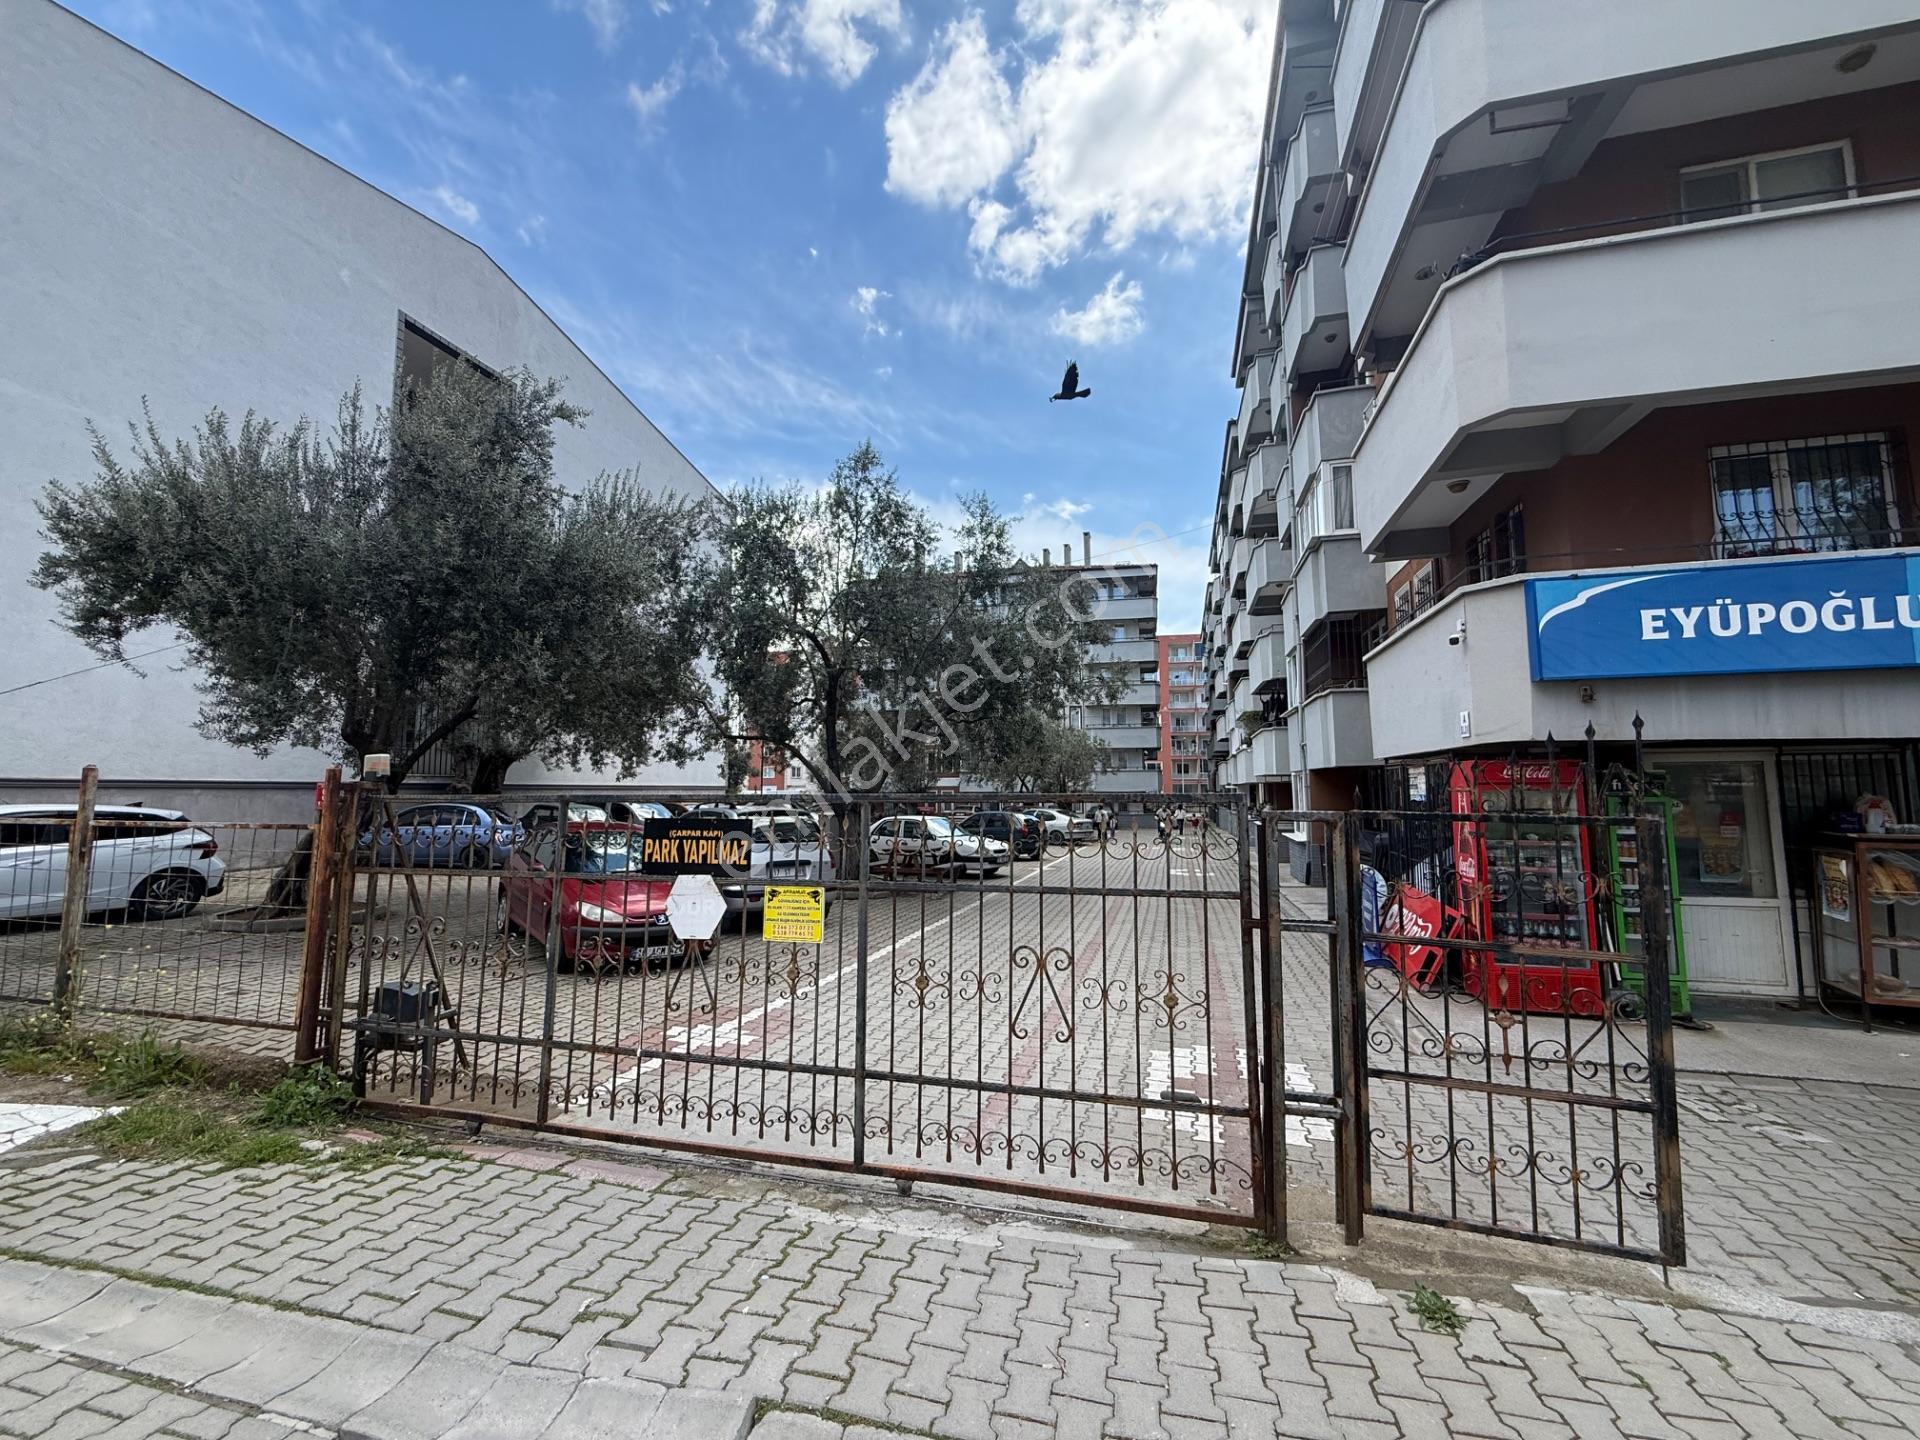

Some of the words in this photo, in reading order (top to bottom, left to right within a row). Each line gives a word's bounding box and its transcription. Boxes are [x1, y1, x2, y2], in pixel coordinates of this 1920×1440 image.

[1640, 589, 1920, 640] EYÜPOĞLU
[1502, 765, 1550, 779] CoaCola
[669, 830, 701, 838] (ÇARPAR
[644, 838, 679, 863] PARK
[683, 839, 749, 865] YAPILMAZ
